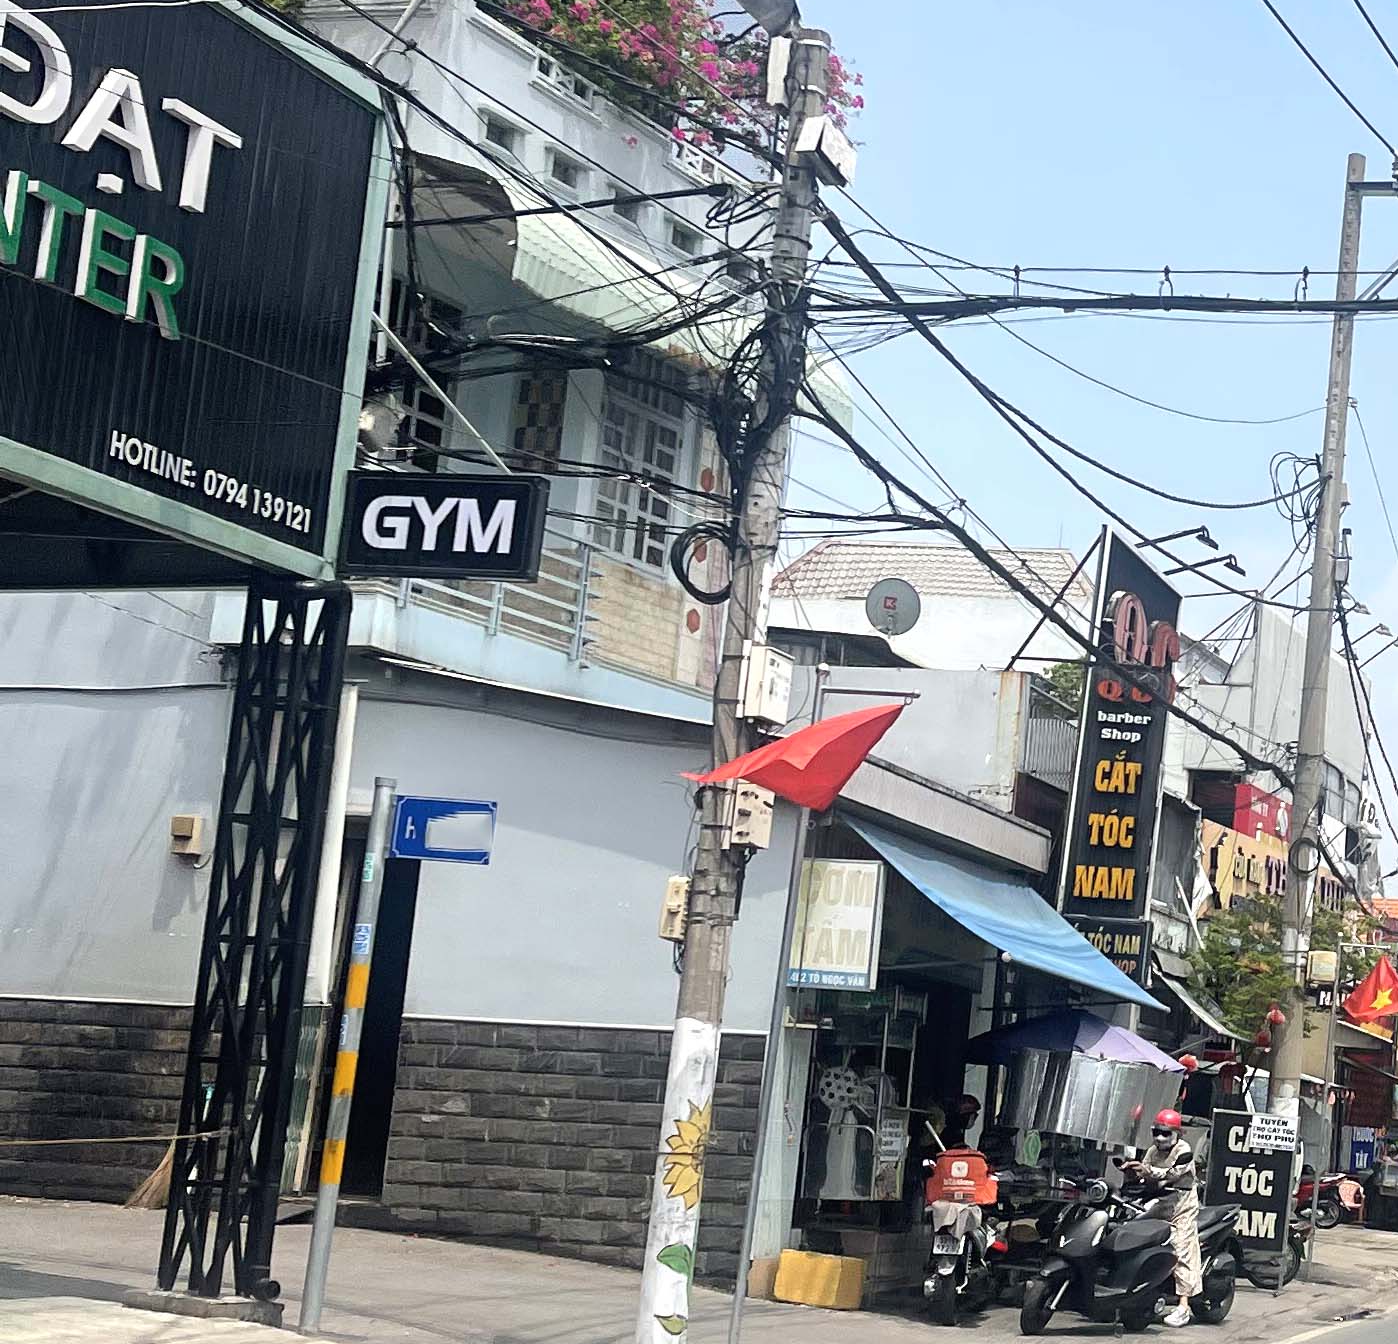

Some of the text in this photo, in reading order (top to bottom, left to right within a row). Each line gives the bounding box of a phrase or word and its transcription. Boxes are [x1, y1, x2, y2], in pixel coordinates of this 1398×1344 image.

[108, 429, 312, 534] HOTLINE: 0794 139121
[361, 494, 518, 555] GYM
[1097, 710, 1152, 725] barber
[1101, 727, 1142, 743] Shop
[1094, 749, 1143, 795] CẮT
[1088, 808, 1135, 849] TÓC
[1072, 864, 1136, 900] NAM
[1113, 934, 1141, 956] NAM
[1224, 1162, 1274, 1197] TÓC
[1233, 1208, 1277, 1239] AM
